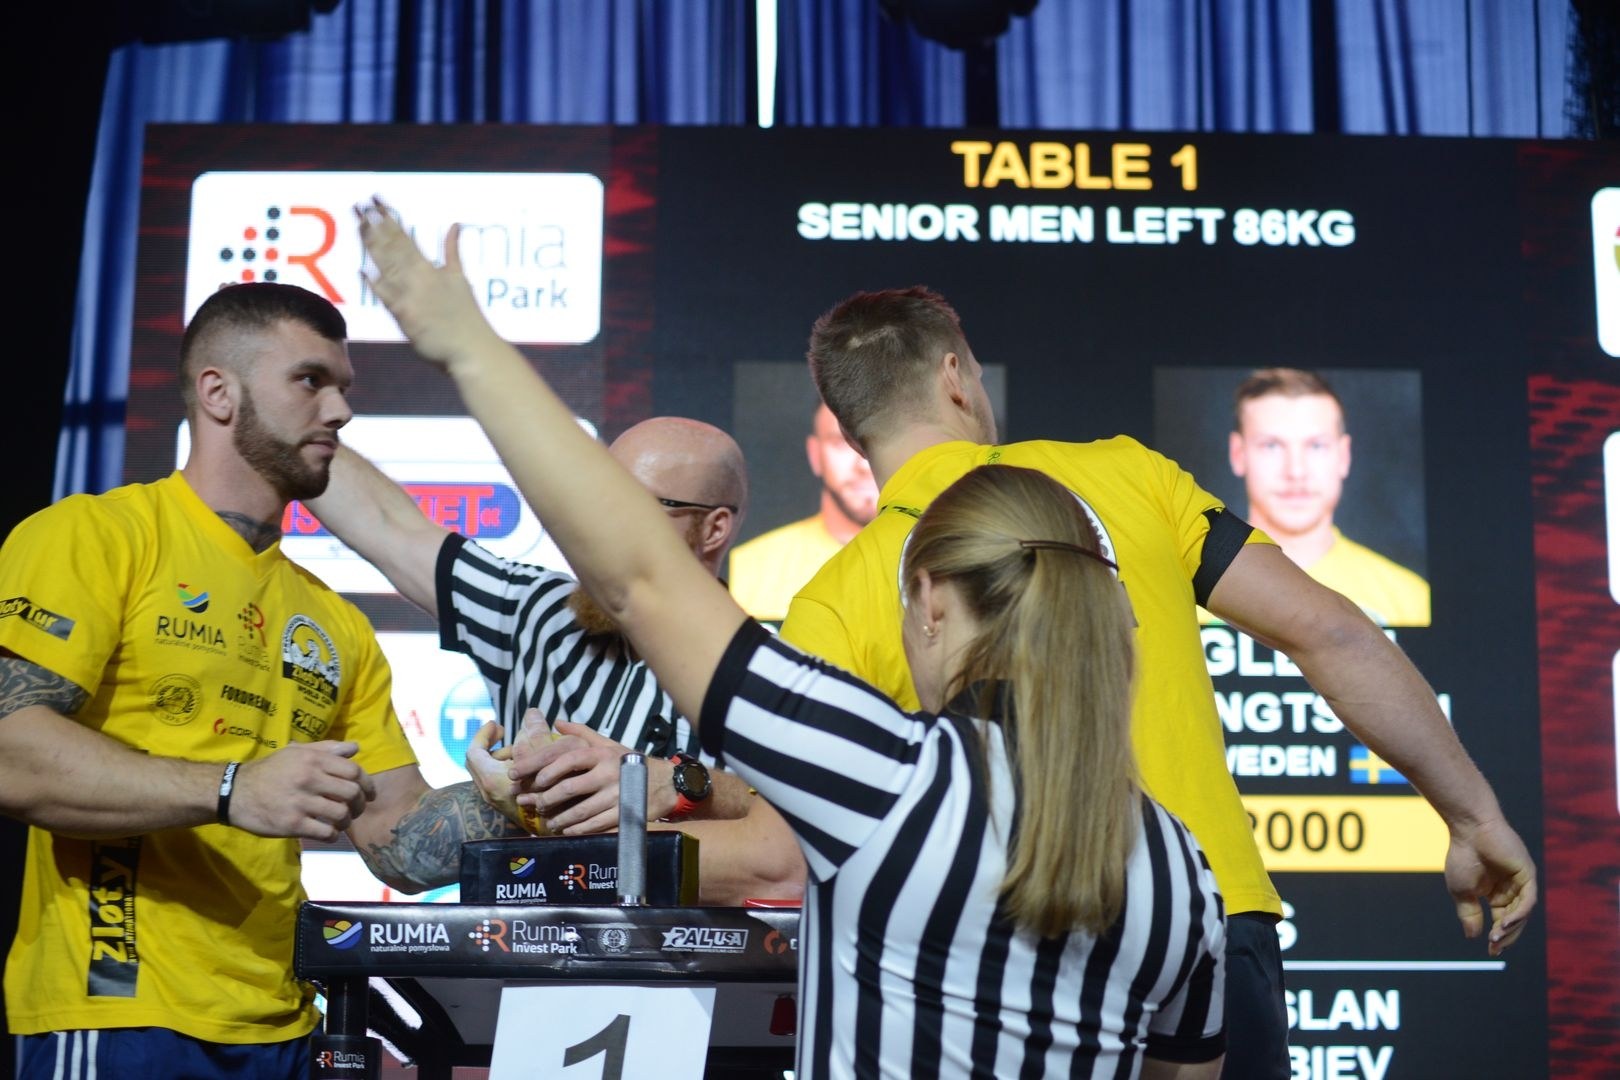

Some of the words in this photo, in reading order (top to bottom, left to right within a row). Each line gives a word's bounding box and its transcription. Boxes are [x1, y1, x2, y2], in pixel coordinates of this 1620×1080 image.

[951, 141, 1152, 190] TABLE
[1171, 144, 1198, 190] 1
[798, 203, 979, 241] SENIOR
[990, 206, 1093, 243] MEN
[1106, 207, 1225, 245] LEFT
[1233, 209, 1356, 246] 86KG
[487, 278, 567, 309] Park
[157, 616, 227, 648] RUMIA
[589, 863, 618, 880] Rum
[496, 883, 547, 899] RUMIA
[589, 881, 614, 890] Invest
[370, 923, 450, 944] RUMIA
[512, 920, 577, 942] Rumia
[512, 942, 548, 953] Invest
[550, 943, 578, 954] Park
[334, 1050, 365, 1063] Rumia
[562, 1013, 631, 1080] 1
